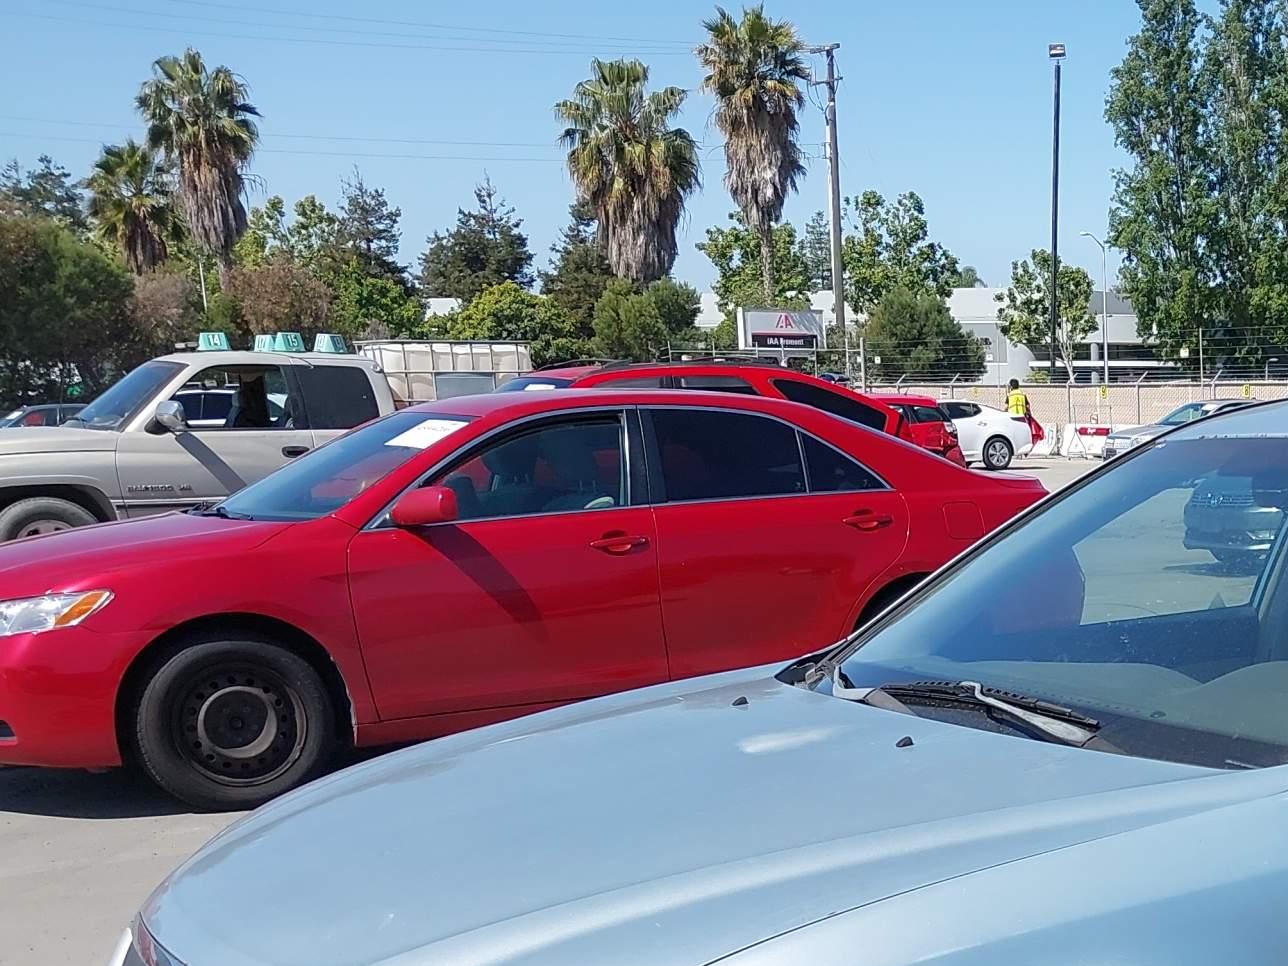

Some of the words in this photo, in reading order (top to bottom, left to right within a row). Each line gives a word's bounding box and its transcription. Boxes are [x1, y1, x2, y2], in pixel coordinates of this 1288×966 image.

[208, 334, 221, 346] 14
[287, 334, 298, 347] 15
[767, 337, 779, 345] IAA
